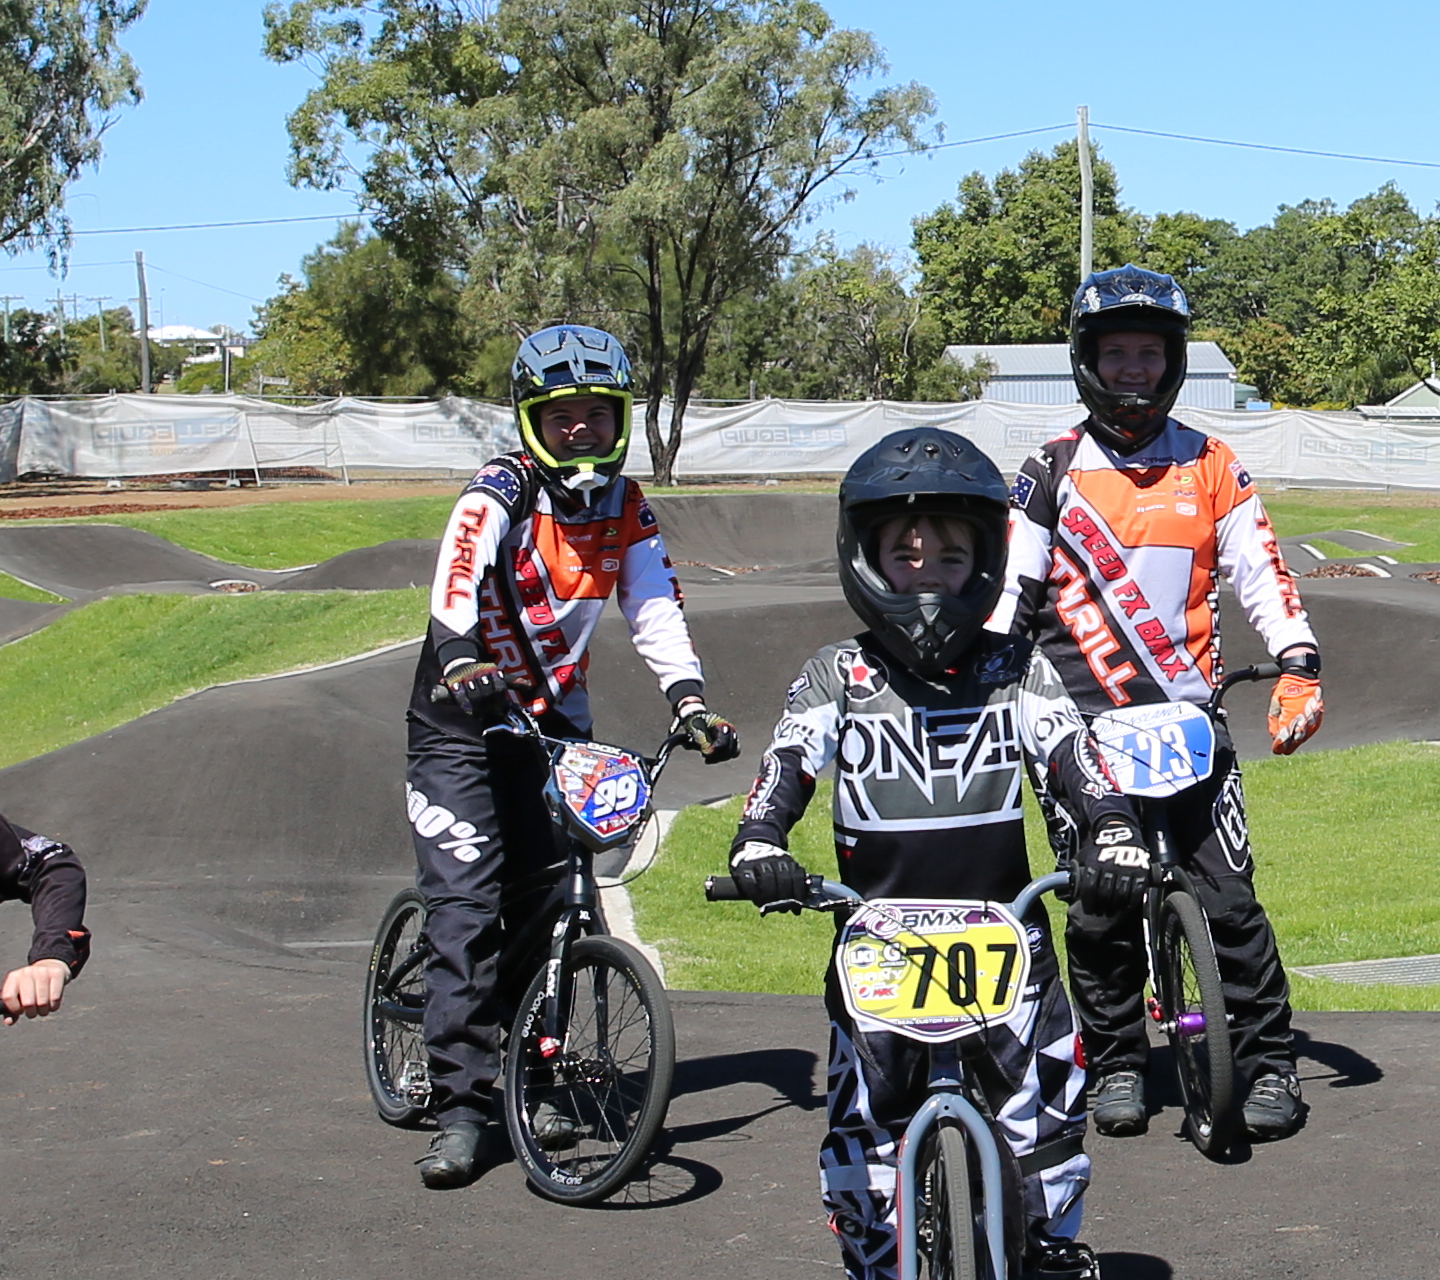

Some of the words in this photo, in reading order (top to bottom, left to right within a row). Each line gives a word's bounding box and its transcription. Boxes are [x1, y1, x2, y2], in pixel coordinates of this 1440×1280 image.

[443, 503, 488, 611] THRILL
[1049, 546, 1139, 707] THRILL
[1061, 506, 1128, 581] SPEED
[1113, 578, 1150, 619] FX
[1134, 617, 1189, 682] BMX
[1135, 723, 1194, 785] 23
[405, 782, 491, 863] 00%
[593, 773, 639, 819] 99
[1098, 846, 1151, 869] FOX
[902, 910, 966, 927] BMX
[544, 959, 562, 998] box
[906, 942, 1017, 1010] 707
